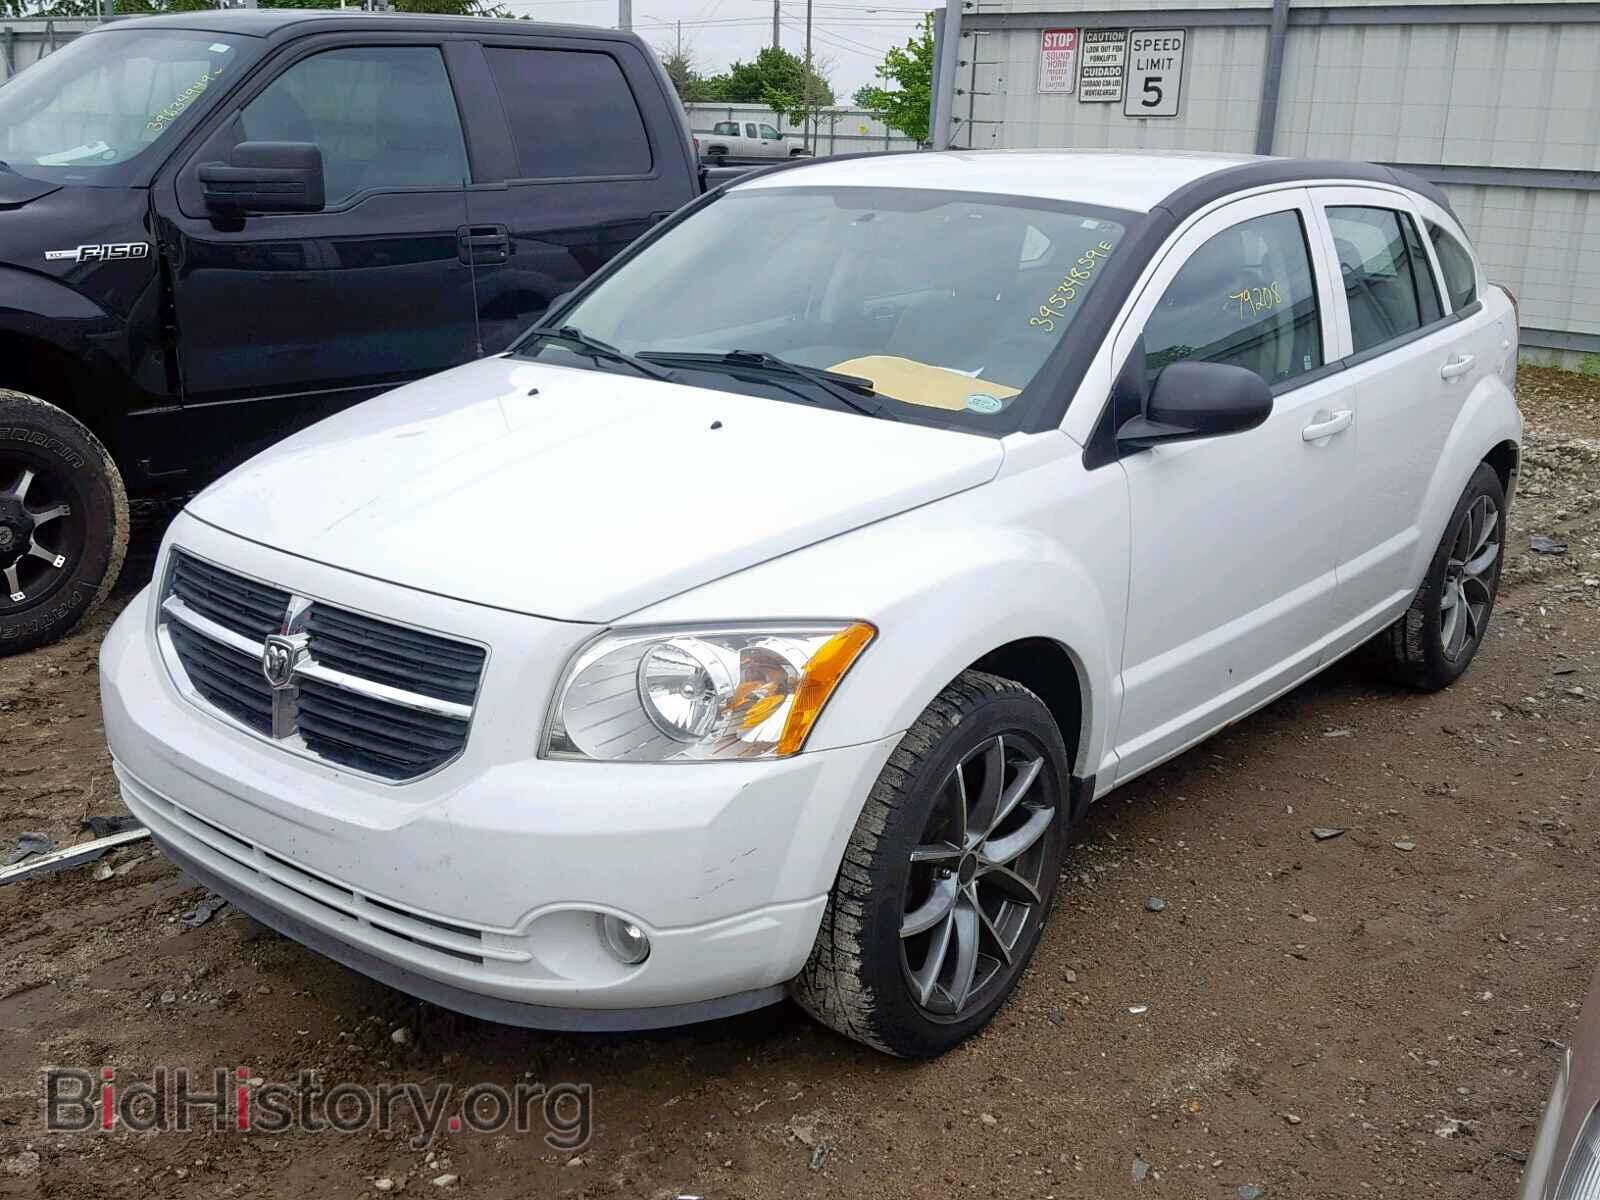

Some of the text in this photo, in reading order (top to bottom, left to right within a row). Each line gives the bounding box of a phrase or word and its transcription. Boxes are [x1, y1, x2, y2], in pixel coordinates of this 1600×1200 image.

[1044, 32, 1074, 48] STOP
[1086, 31, 1125, 41] CAUTION
[1100, 45, 1111, 53] OUT
[1133, 38, 1181, 51] SPEED
[1089, 54, 1117, 62] FORKLIFTS
[1137, 57, 1174, 71] LIMIT
[1083, 67, 1121, 76] CUIDADO
[1141, 76, 1162, 107] 5
[77, 242, 149, 262] F-150
[1229, 280, 1282, 321] 79208
